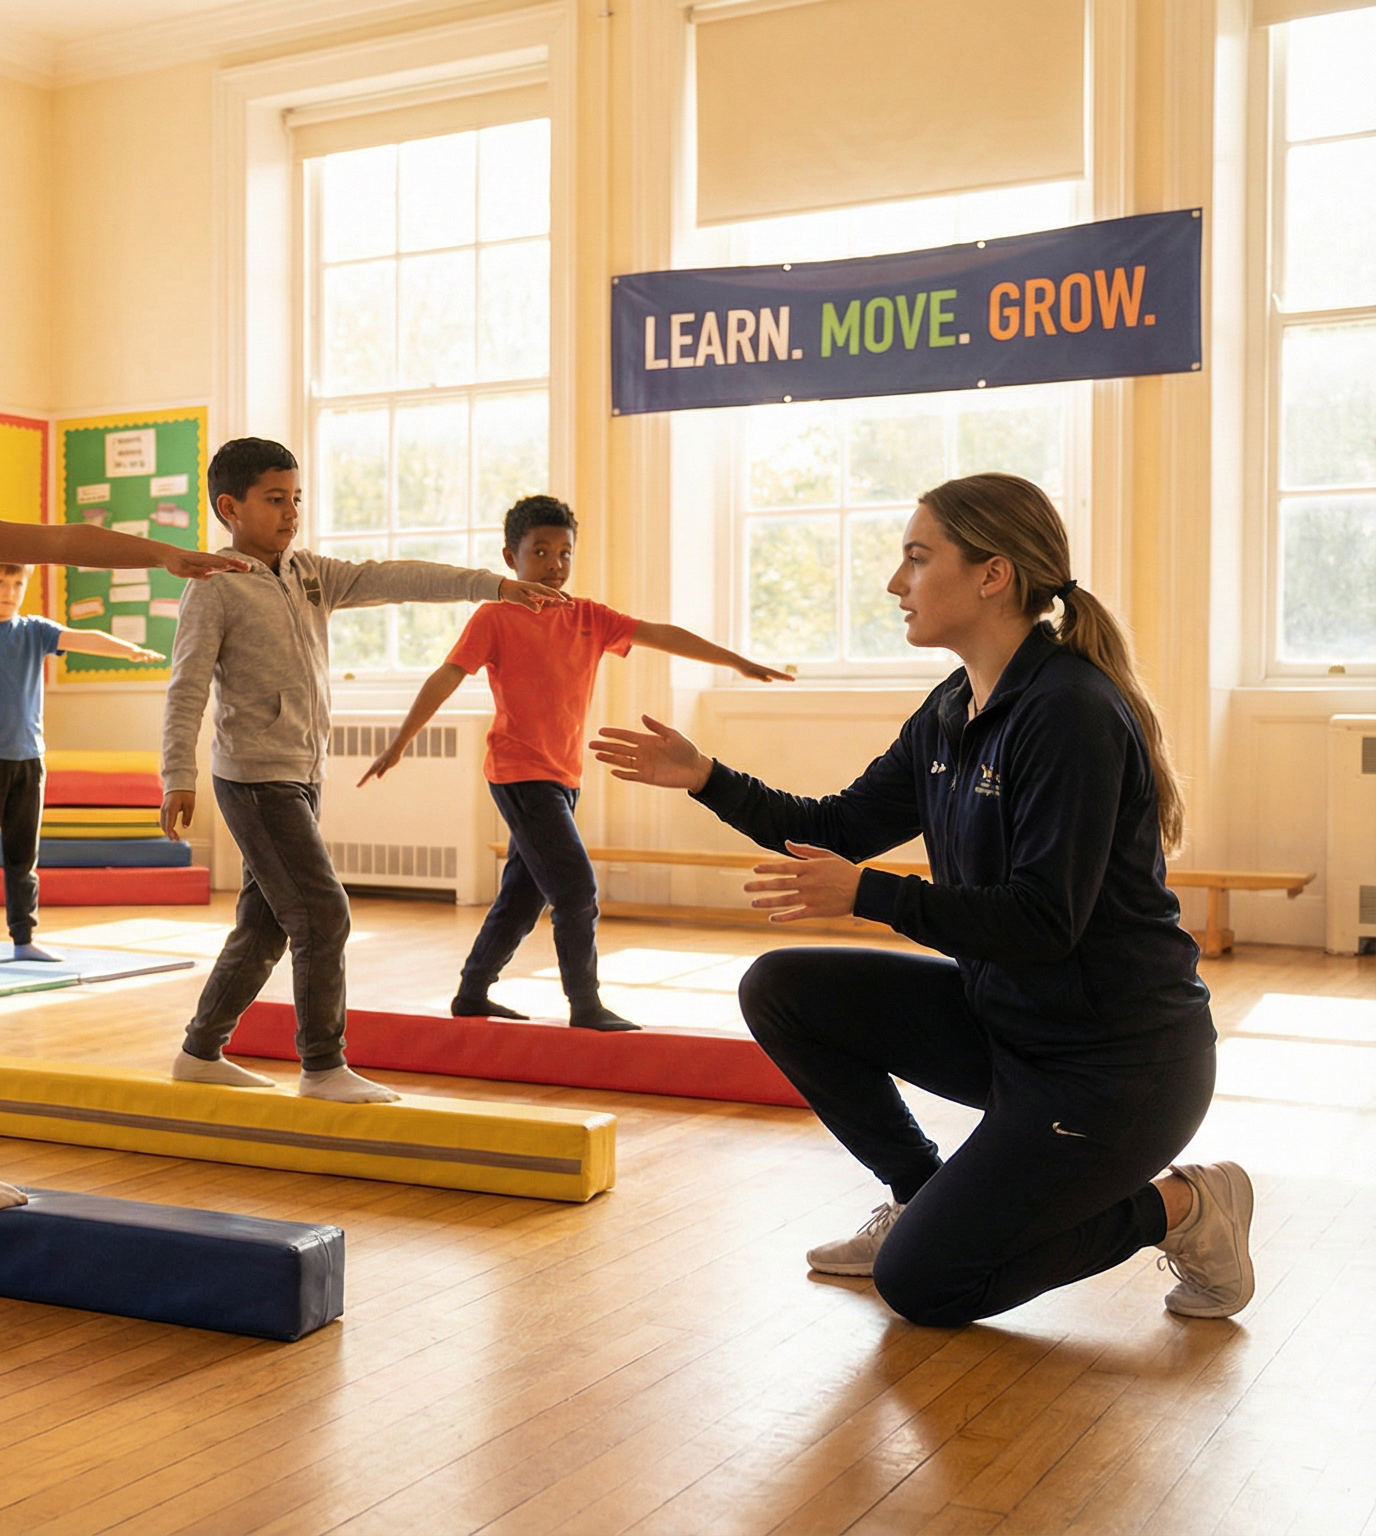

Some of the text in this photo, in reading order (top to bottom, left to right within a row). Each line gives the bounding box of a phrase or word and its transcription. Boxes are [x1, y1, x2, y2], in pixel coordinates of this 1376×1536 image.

[644, 265, 1157, 370] LEARN. MOVE. GROW.
